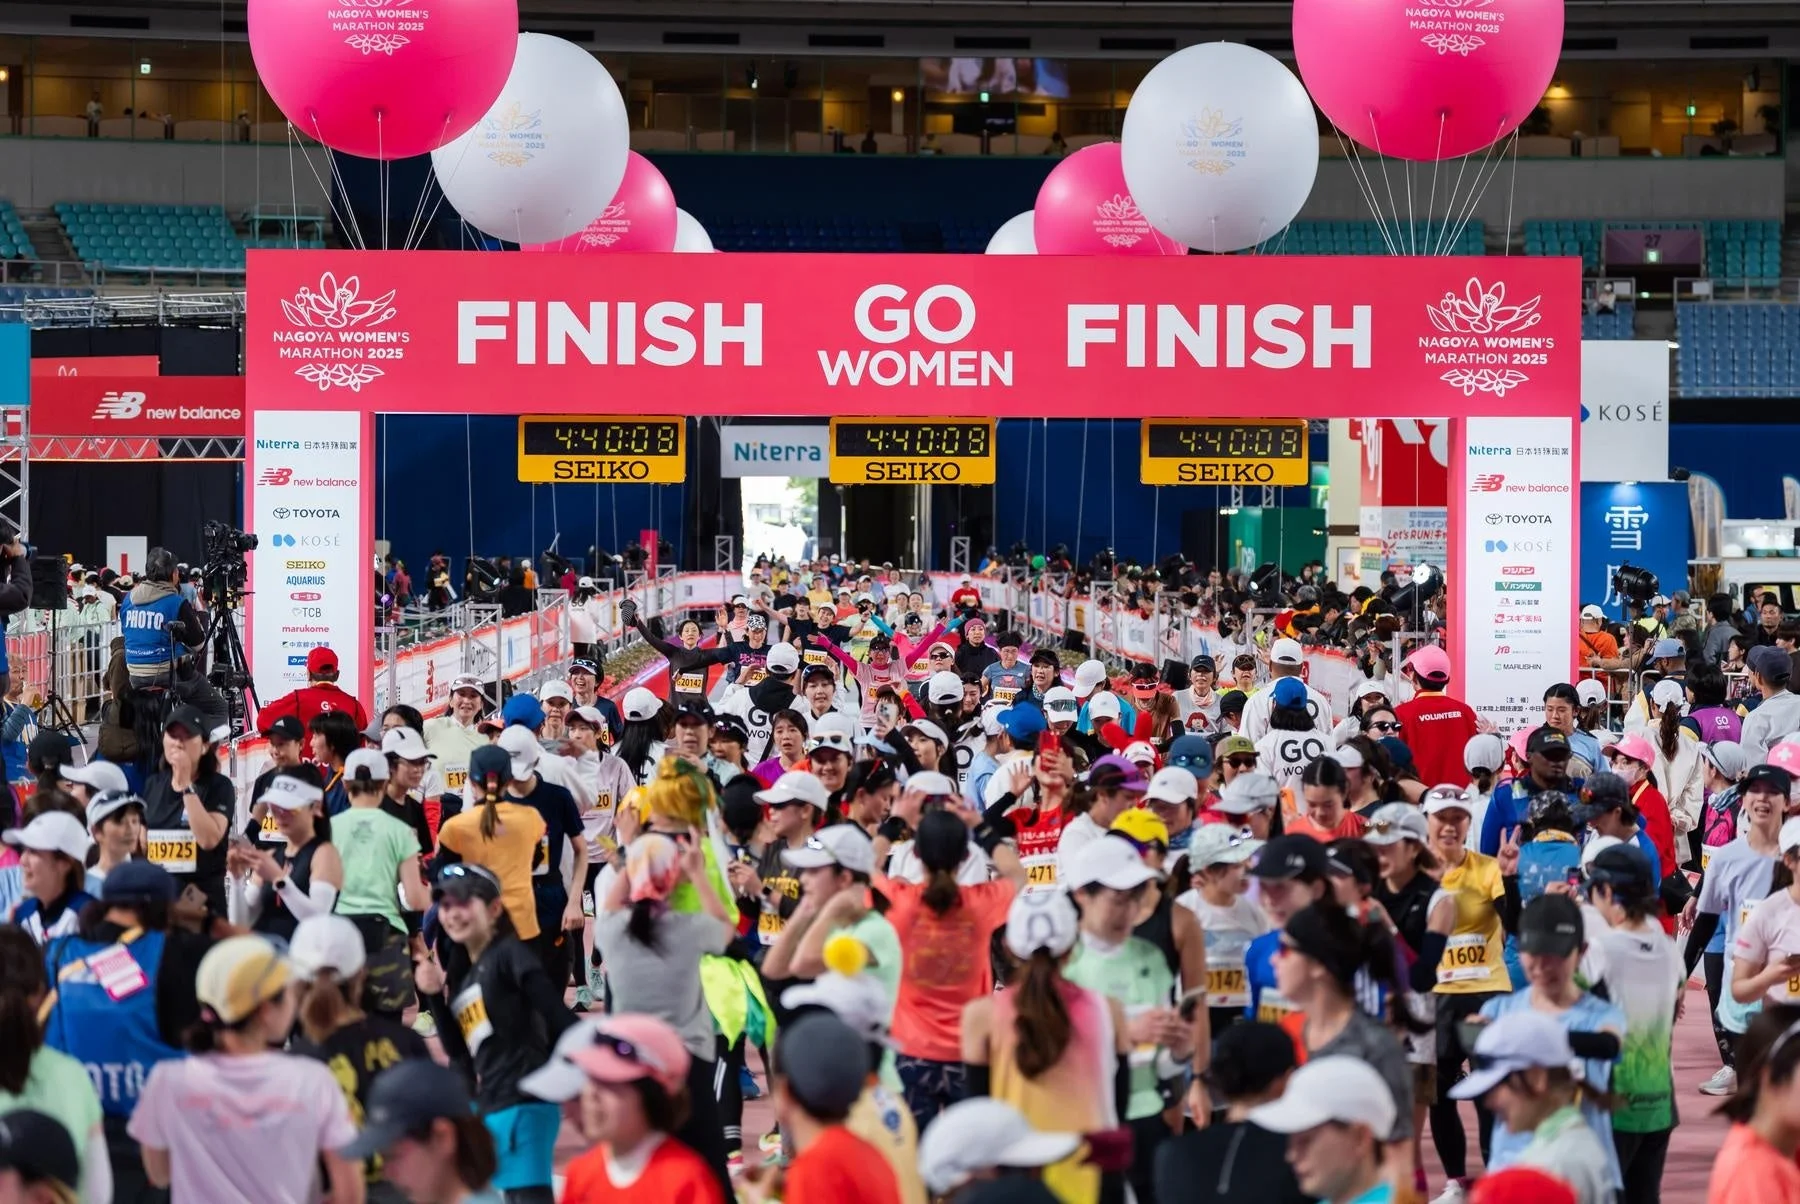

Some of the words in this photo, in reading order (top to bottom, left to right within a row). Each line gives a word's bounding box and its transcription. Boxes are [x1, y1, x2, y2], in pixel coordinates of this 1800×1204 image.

[328, 10, 373, 18] NAGOYA
[376, 10, 429, 19] WOMEN'S
[1405, 8, 1451, 17] NAGOYA
[1455, 9, 1505, 21] WOMEN'S
[333, 22, 395, 31] MARATHON
[398, 22, 424, 31] 2025
[1410, 20, 1473, 31] MARATHON
[1475, 24, 1500, 33] 2025
[1644, 234, 1662, 248] 27
[854, 283, 976, 344] GO
[273, 331, 335, 342] NAGOYA
[338, 331, 410, 343] WOMEN'S
[457, 301, 763, 366] FINISH
[1067, 304, 1372, 369] FINISH
[1418, 336, 1480, 348] NAGOYA
[1484, 336, 1554, 349] WOMEN'S
[279, 347, 364, 359] MARATHON
[367, 348, 404, 359] 2025
[1425, 352, 1507, 364] MARATHON
[1511, 353, 1548, 365] 2025
[817, 350, 1013, 387] WOMEN
[146, 408, 177, 419] new
[180, 406, 241, 419] balance
[1599, 401, 1663, 422] KOSÉ
[256, 440, 300, 449] Niterra
[1469, 446, 1512, 455] Niterra
[734, 441, 821, 462] Niterra
[554, 460, 649, 480] SEIKO
[866, 462, 961, 481] SEIKO
[1178, 463, 1274, 482] SEIKO
[293, 479, 314, 487] new
[316, 478, 358, 487] balance
[1505, 485, 1526, 493] new
[1528, 483, 1569, 493] balance
[293, 509, 340, 518] TOYOTA
[1505, 515, 1553, 524] TOYOTA
[286, 561, 326, 570] SEIKO
[286, 576, 326, 586] AQUARIUS
[302, 608, 322, 618] TCB
[125, 610, 165, 631] PHOTO
[282, 624, 330, 633] marukome
[1503, 663, 1541, 671] MARUSHIN
[1418, 710, 1462, 722] VOLUNTEER
[1714, 715, 1729, 726] GO
[1280, 738, 1325, 763] GO
[1447, 945, 1486, 967] 1602
